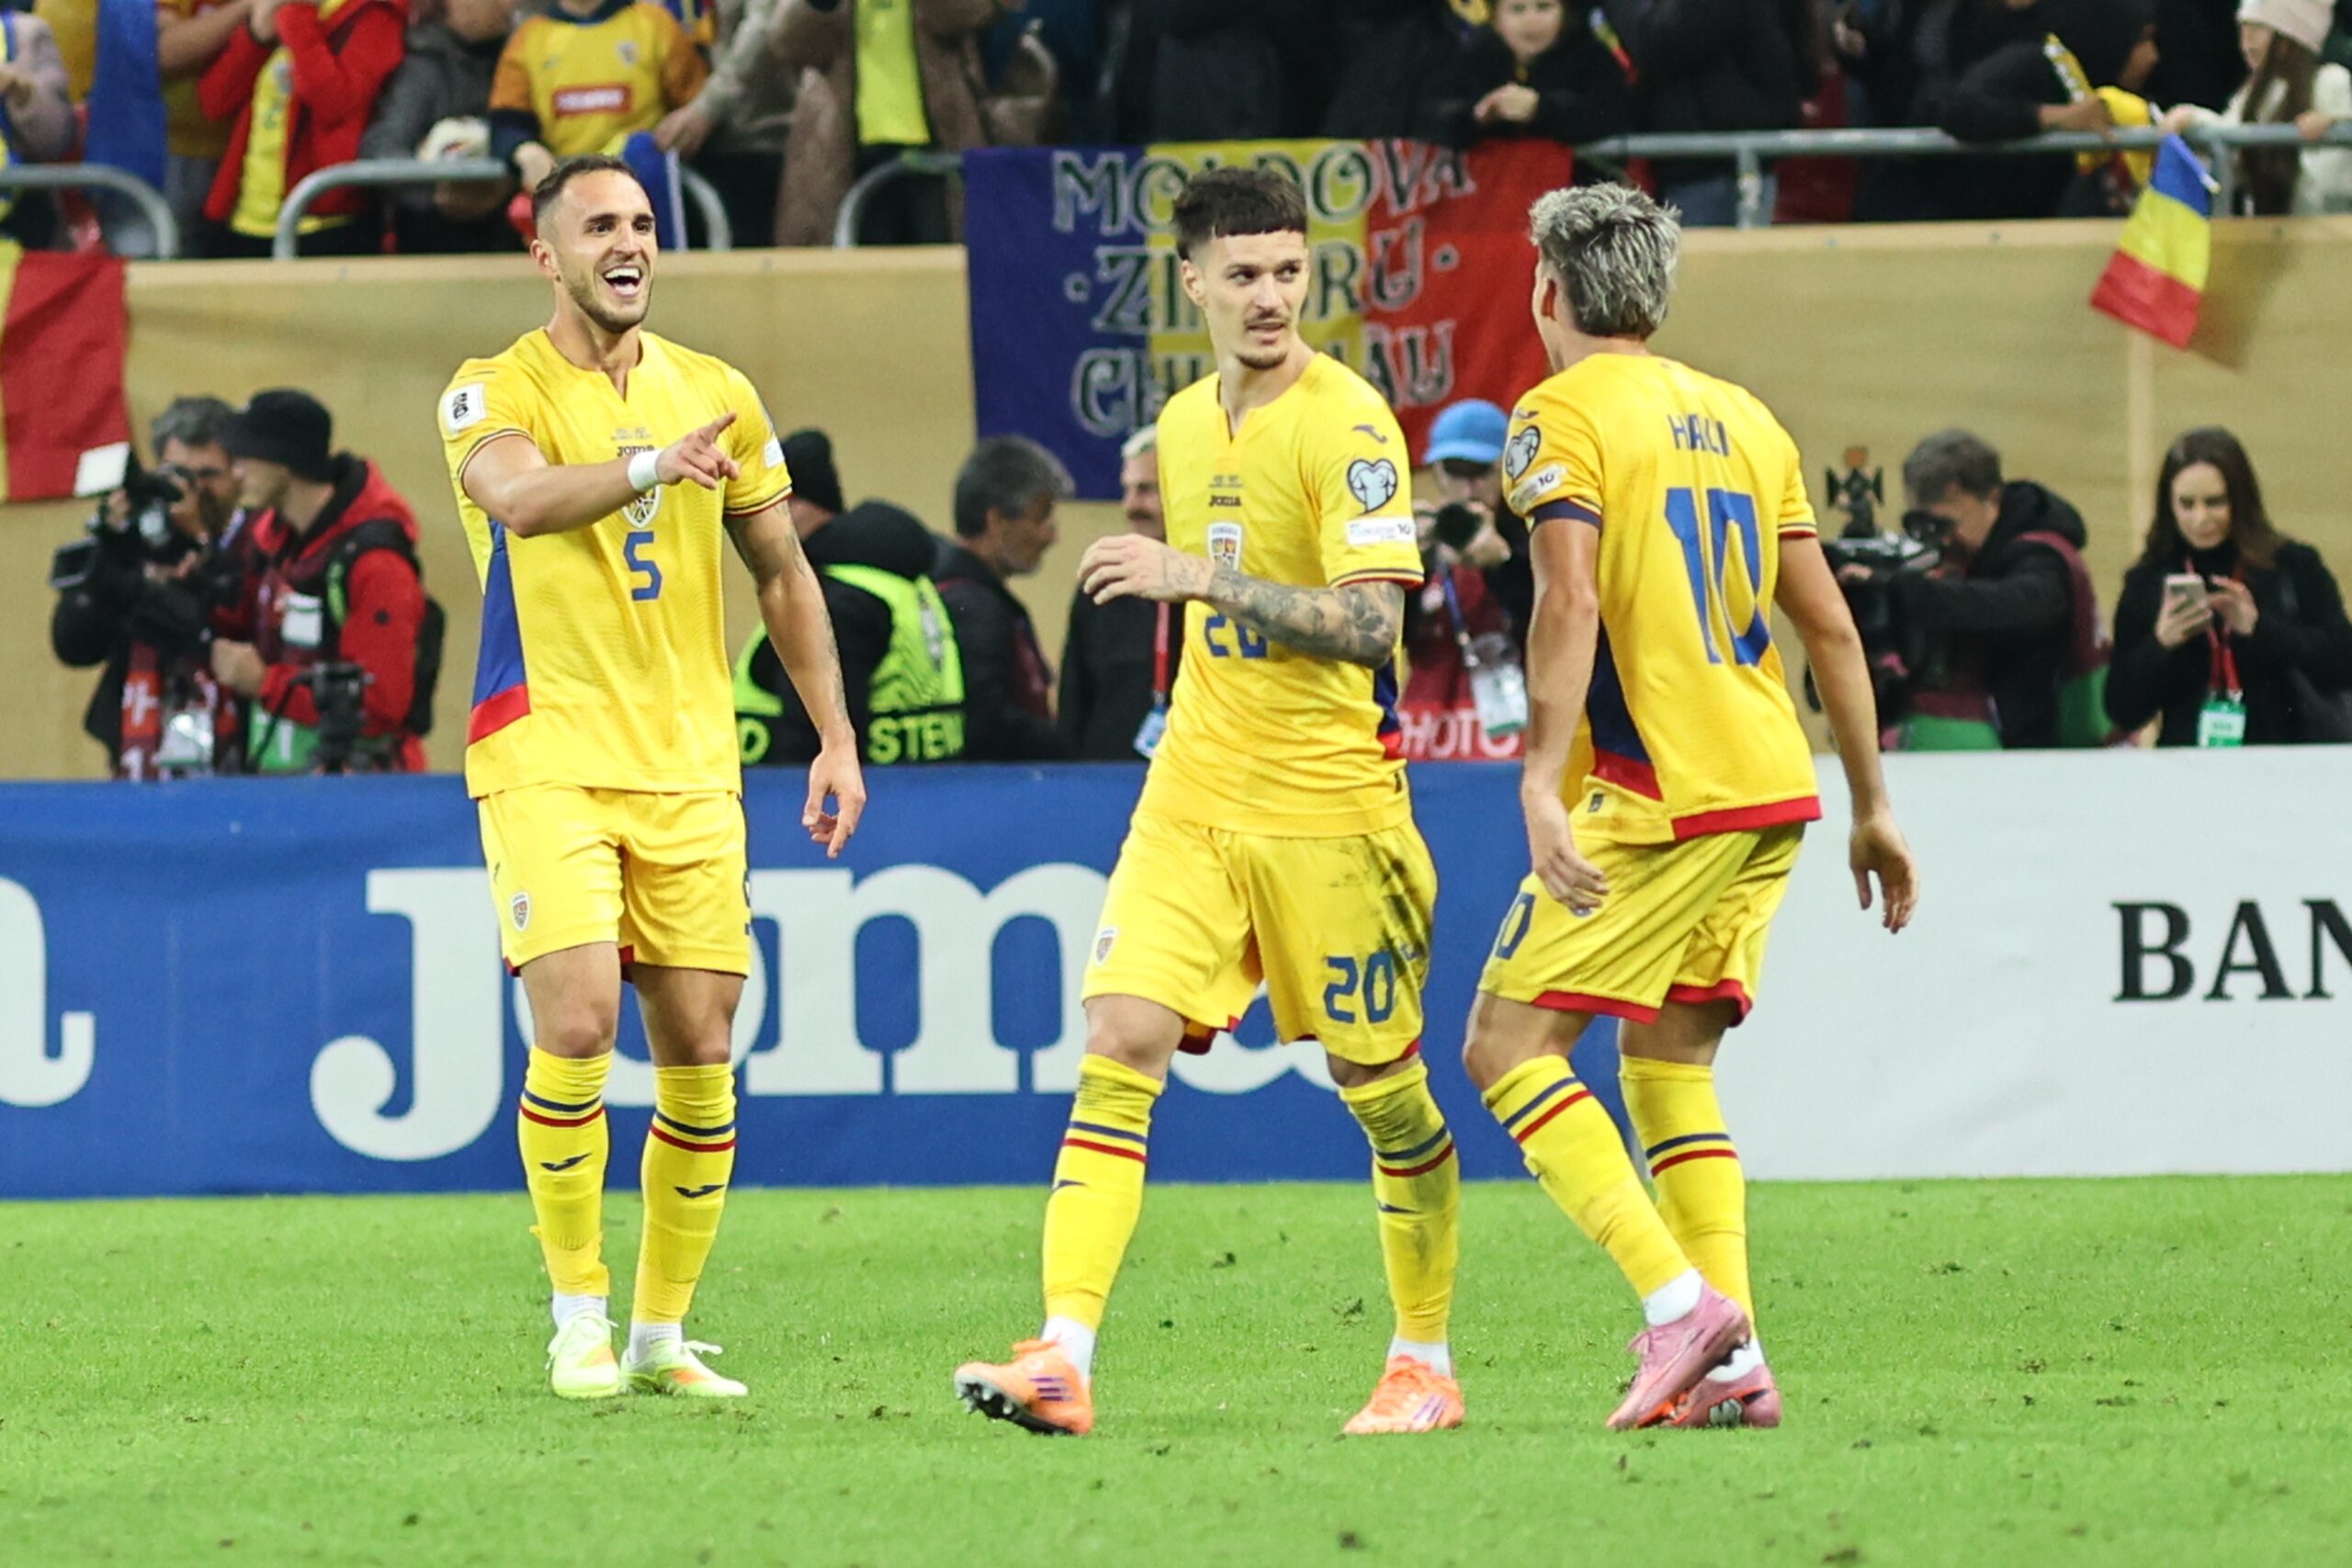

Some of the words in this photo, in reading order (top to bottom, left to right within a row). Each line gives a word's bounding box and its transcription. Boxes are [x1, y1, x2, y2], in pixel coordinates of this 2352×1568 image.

[1052, 138, 1476, 236] MOOVA
[1091, 216, 1426, 333] ZIRU
[623, 530, 662, 602] 5
[1664, 487, 1770, 667] 10
[1323, 950, 1395, 1024] 20
